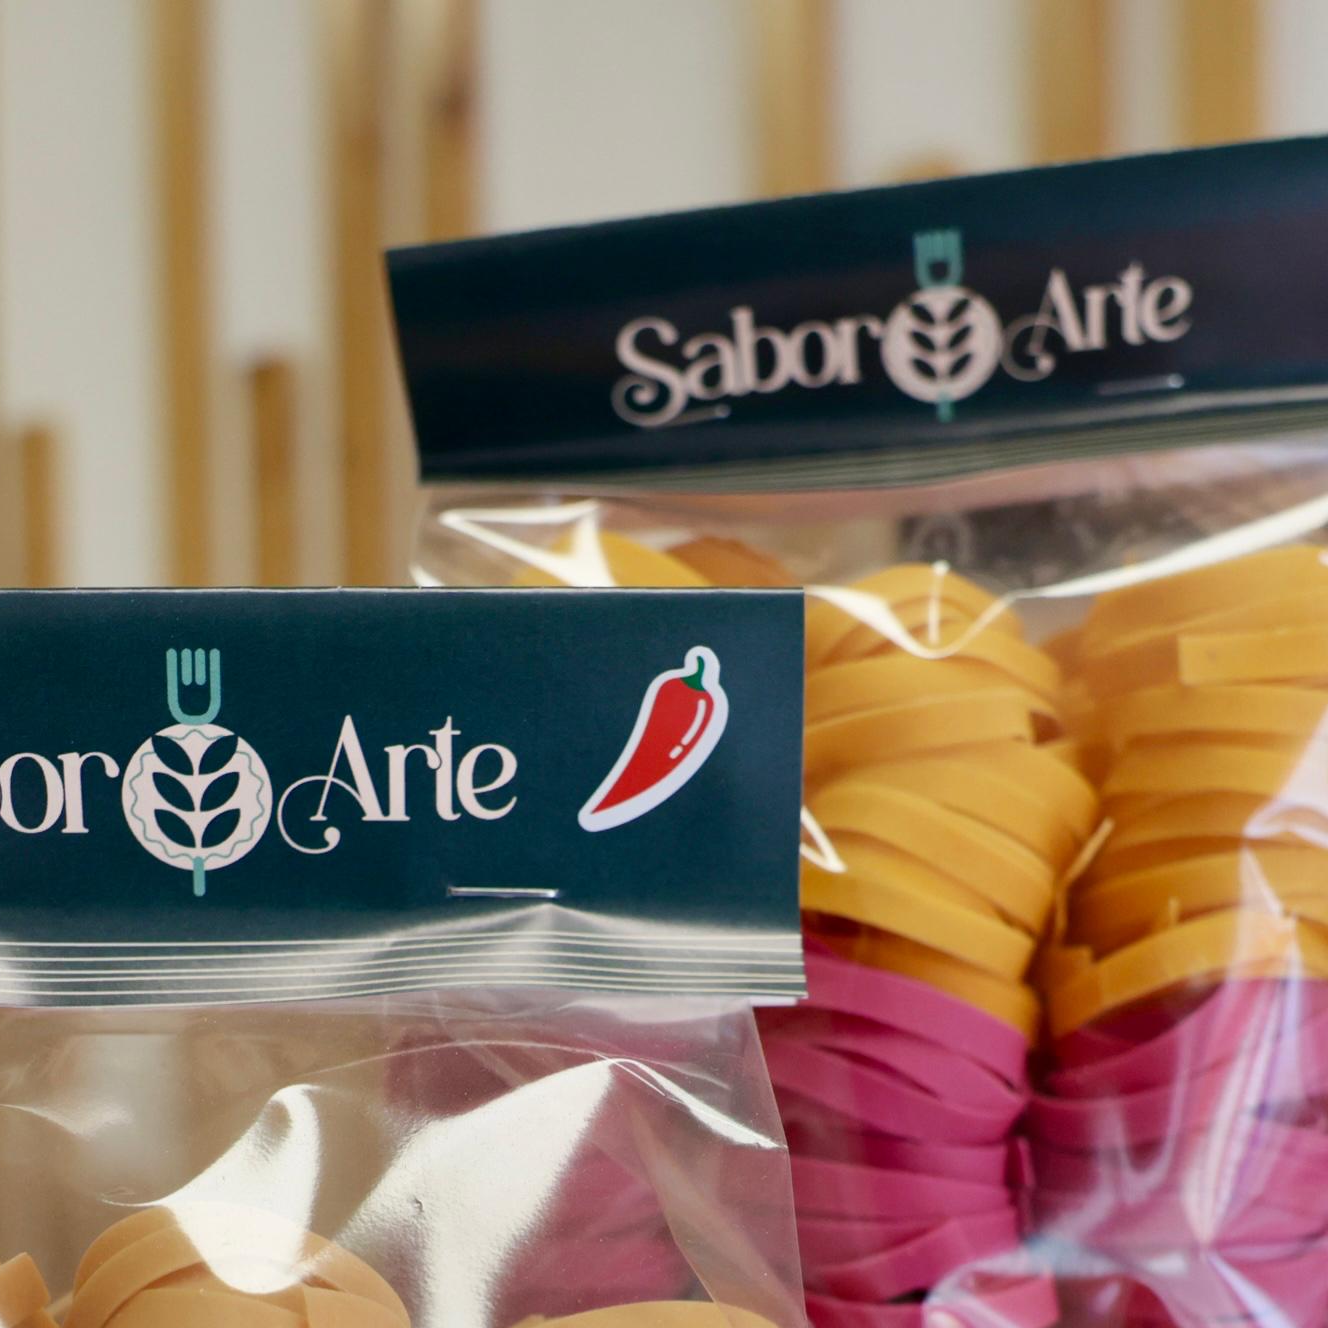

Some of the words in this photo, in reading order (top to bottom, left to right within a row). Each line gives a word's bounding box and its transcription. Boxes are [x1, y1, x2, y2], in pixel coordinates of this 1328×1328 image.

[612, 306, 883, 427] Sabor
[1002, 262, 1192, 383] Arte
[277, 714, 519, 855] Arte
